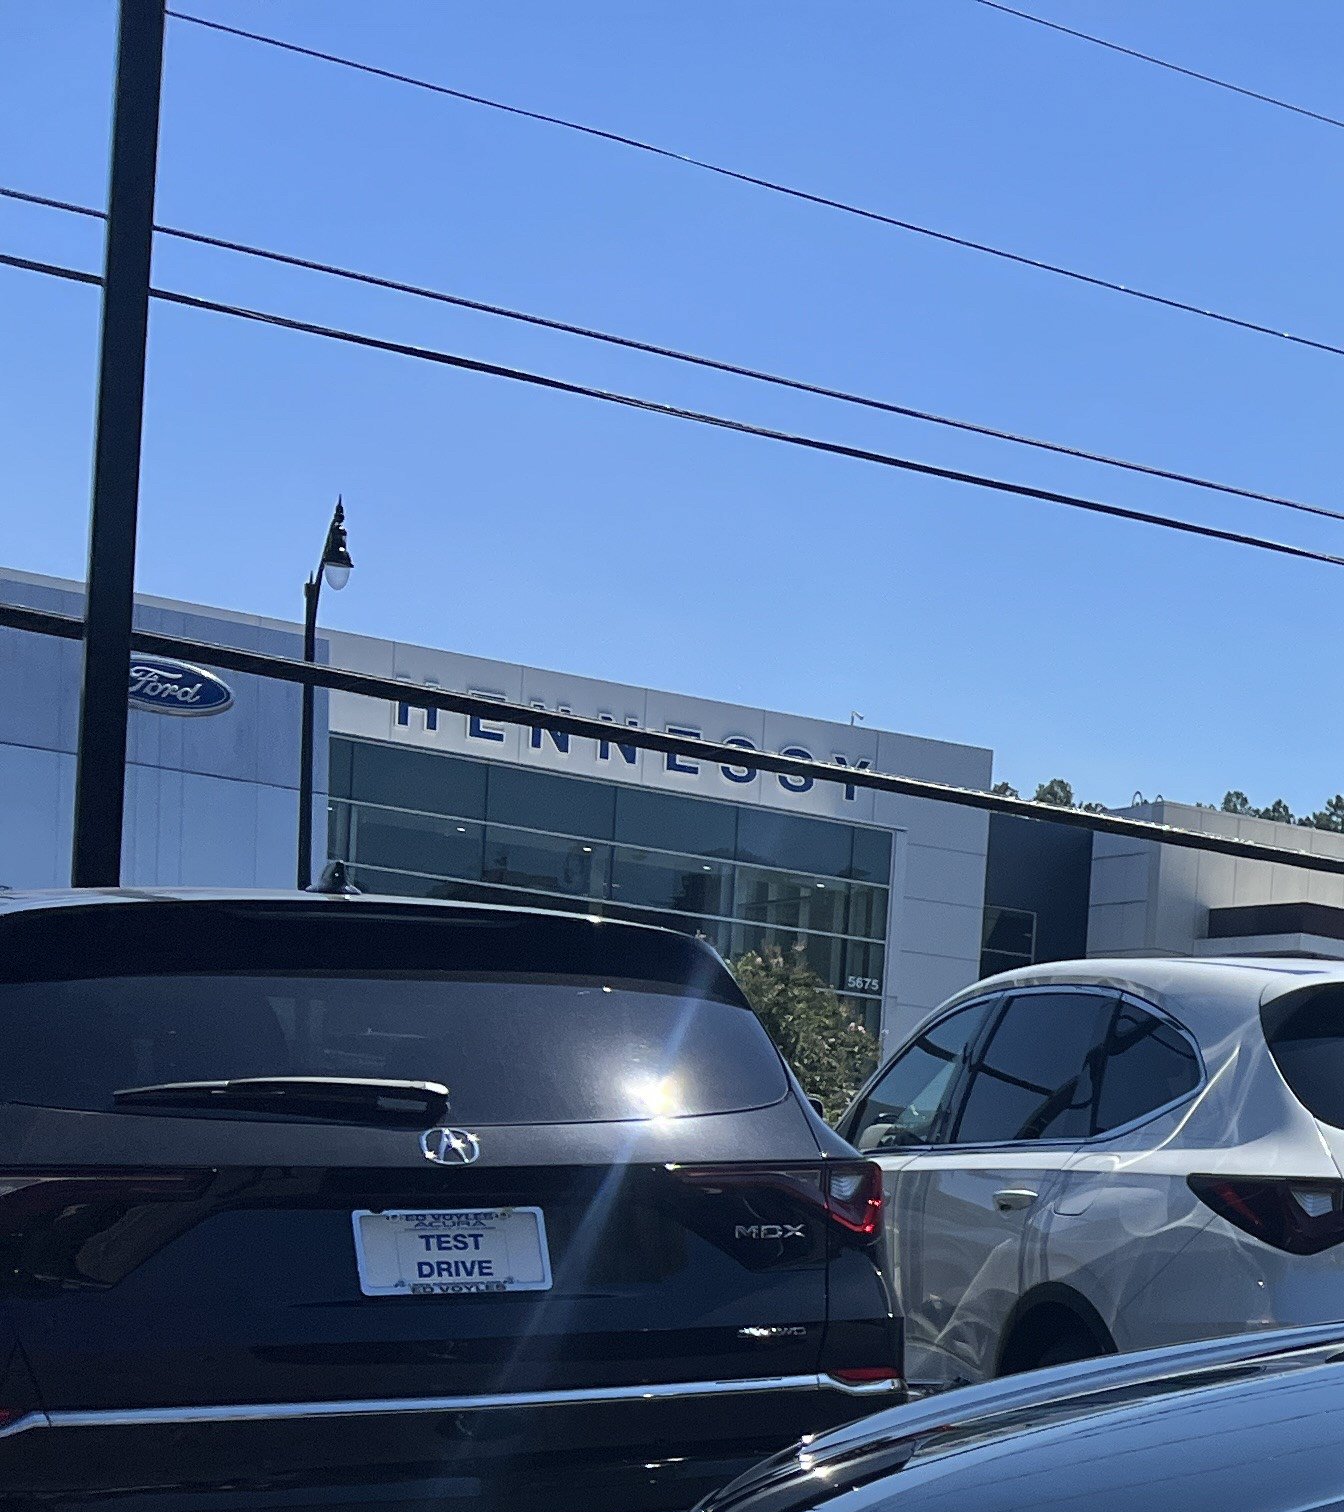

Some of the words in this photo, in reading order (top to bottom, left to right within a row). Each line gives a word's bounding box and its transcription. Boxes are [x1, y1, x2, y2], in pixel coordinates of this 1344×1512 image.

[128, 665, 203, 703] Ford
[394, 676, 874, 800] HENNESSY
[847, 975, 879, 991] 5675
[414, 1220, 487, 1229] ACURA
[735, 1223, 806, 1239] MDX
[418, 1233, 484, 1252] TEST
[416, 1260, 495, 1279] DRIVE
